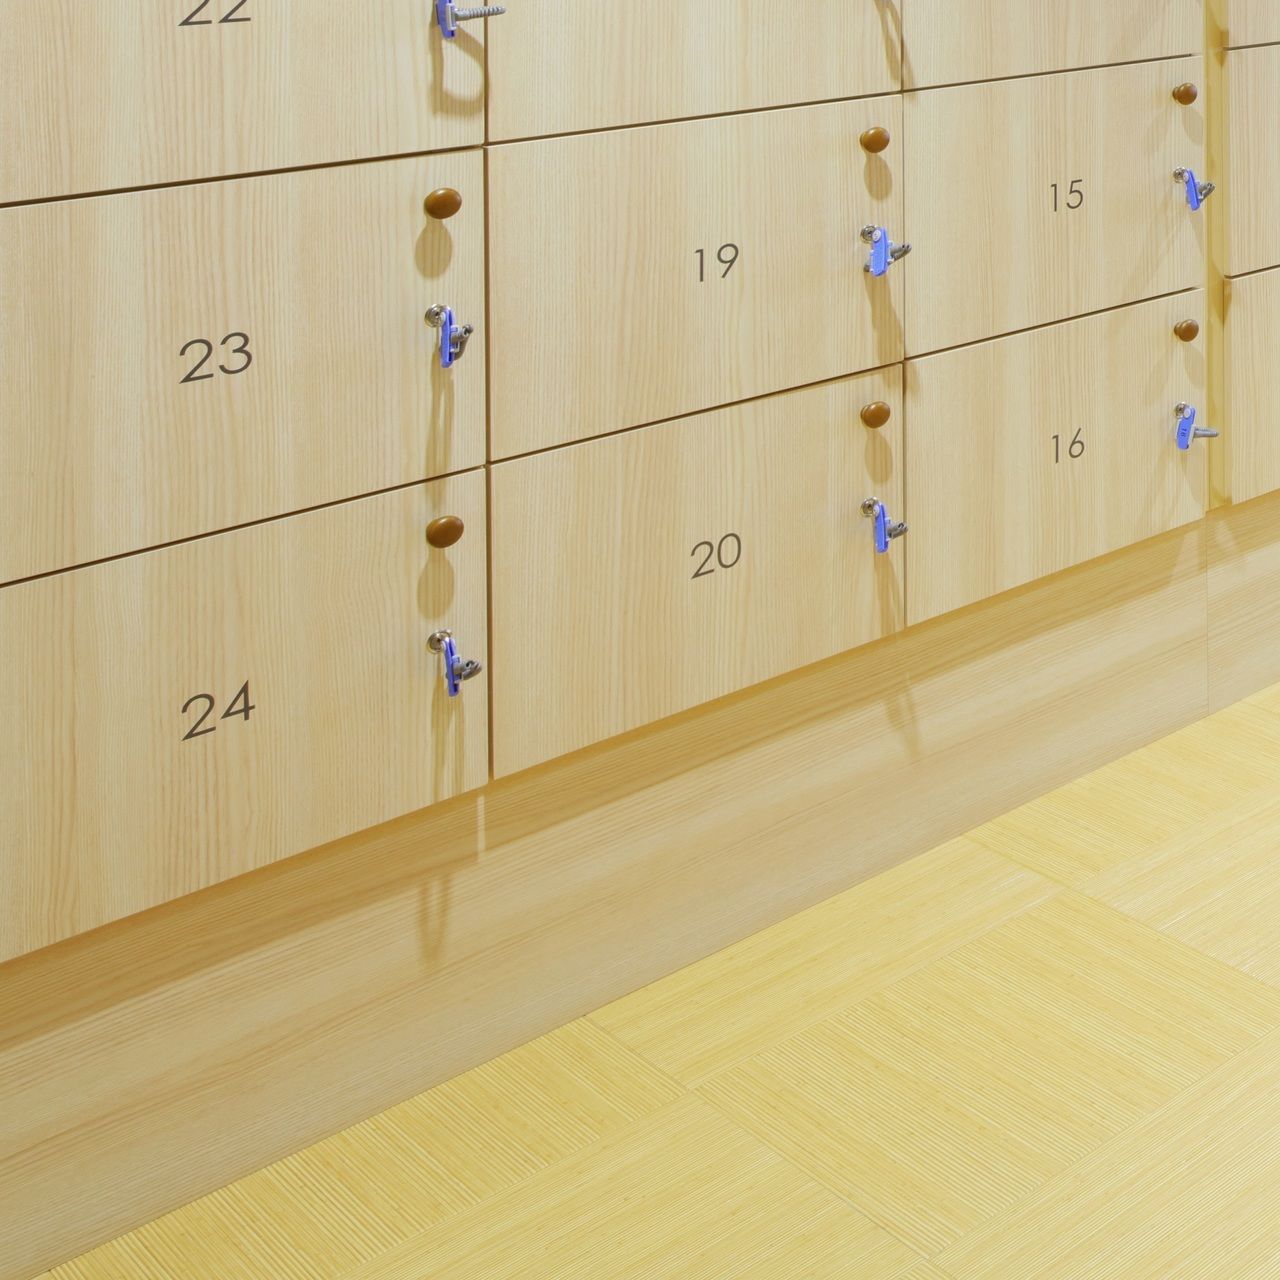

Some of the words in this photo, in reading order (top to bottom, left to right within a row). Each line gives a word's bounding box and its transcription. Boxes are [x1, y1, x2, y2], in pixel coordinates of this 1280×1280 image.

[1050, 178, 1084, 213] 15
[694, 243, 739, 283] 19
[179, 331, 253, 385] 23
[1051, 427, 1085, 464] 16
[690, 532, 742, 580] 20
[181, 679, 256, 742] 24
